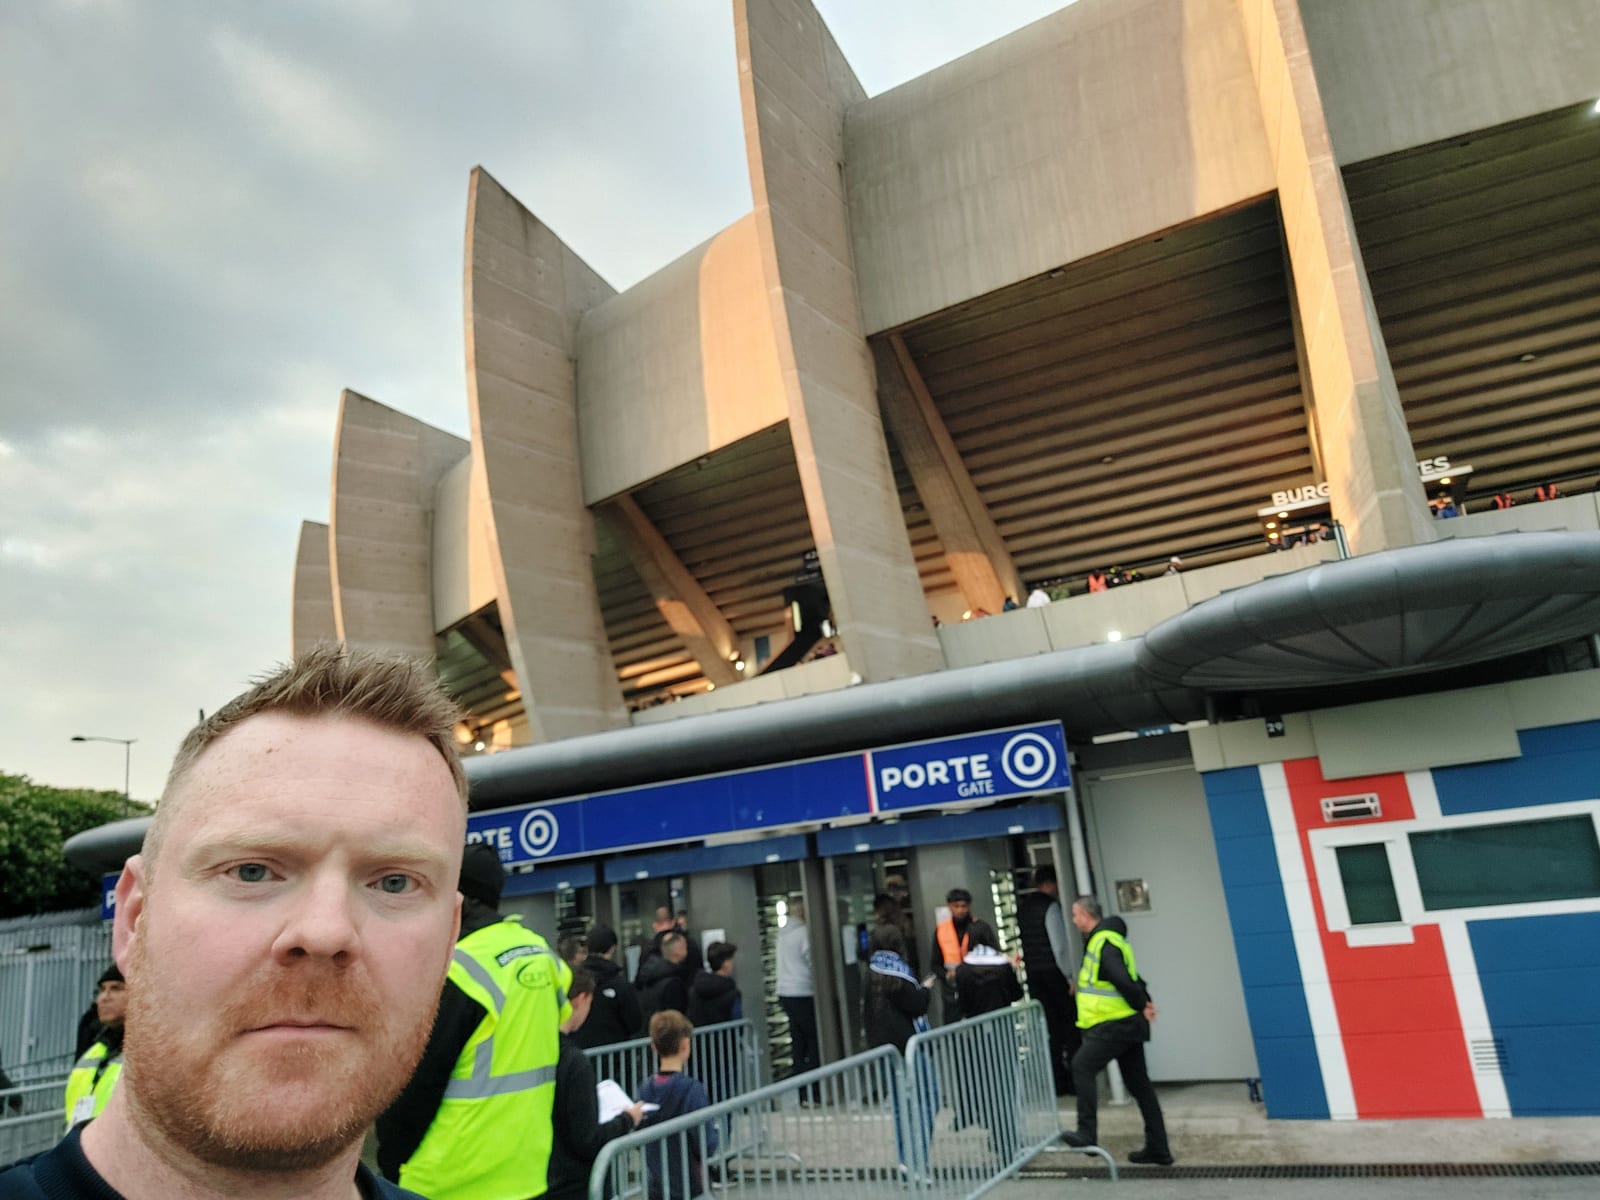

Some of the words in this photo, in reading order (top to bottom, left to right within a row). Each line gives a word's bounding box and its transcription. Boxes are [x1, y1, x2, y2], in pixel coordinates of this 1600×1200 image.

[1271, 481, 1329, 506] BURG
[1416, 456, 1451, 475] ES
[881, 753, 992, 791] PORTE
[957, 779, 995, 797] GATE
[466, 826, 513, 848] RTE
